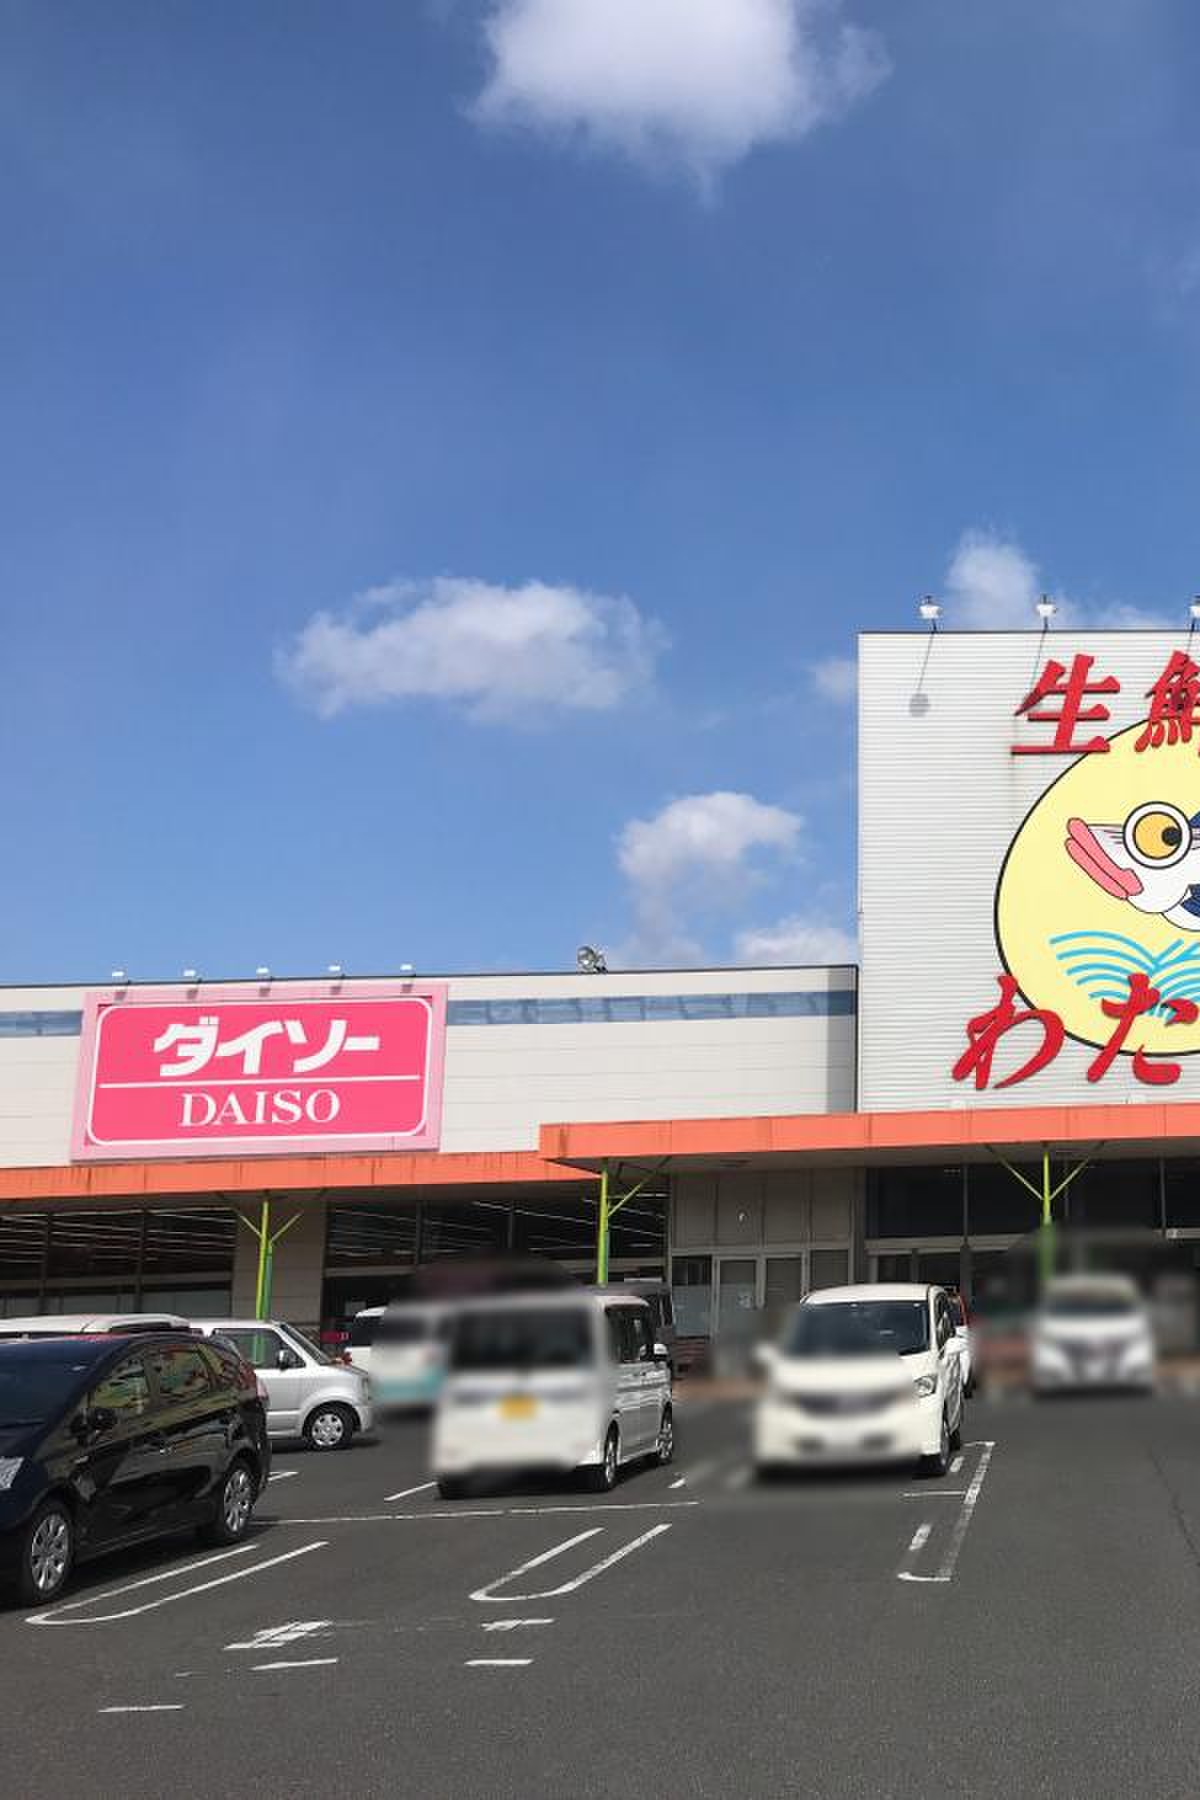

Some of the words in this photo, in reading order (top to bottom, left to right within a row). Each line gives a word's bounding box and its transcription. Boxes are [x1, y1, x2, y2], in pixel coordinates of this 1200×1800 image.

[153, 1016, 381, 1077] ダイソー
[180, 1086, 341, 1128] DAISO
